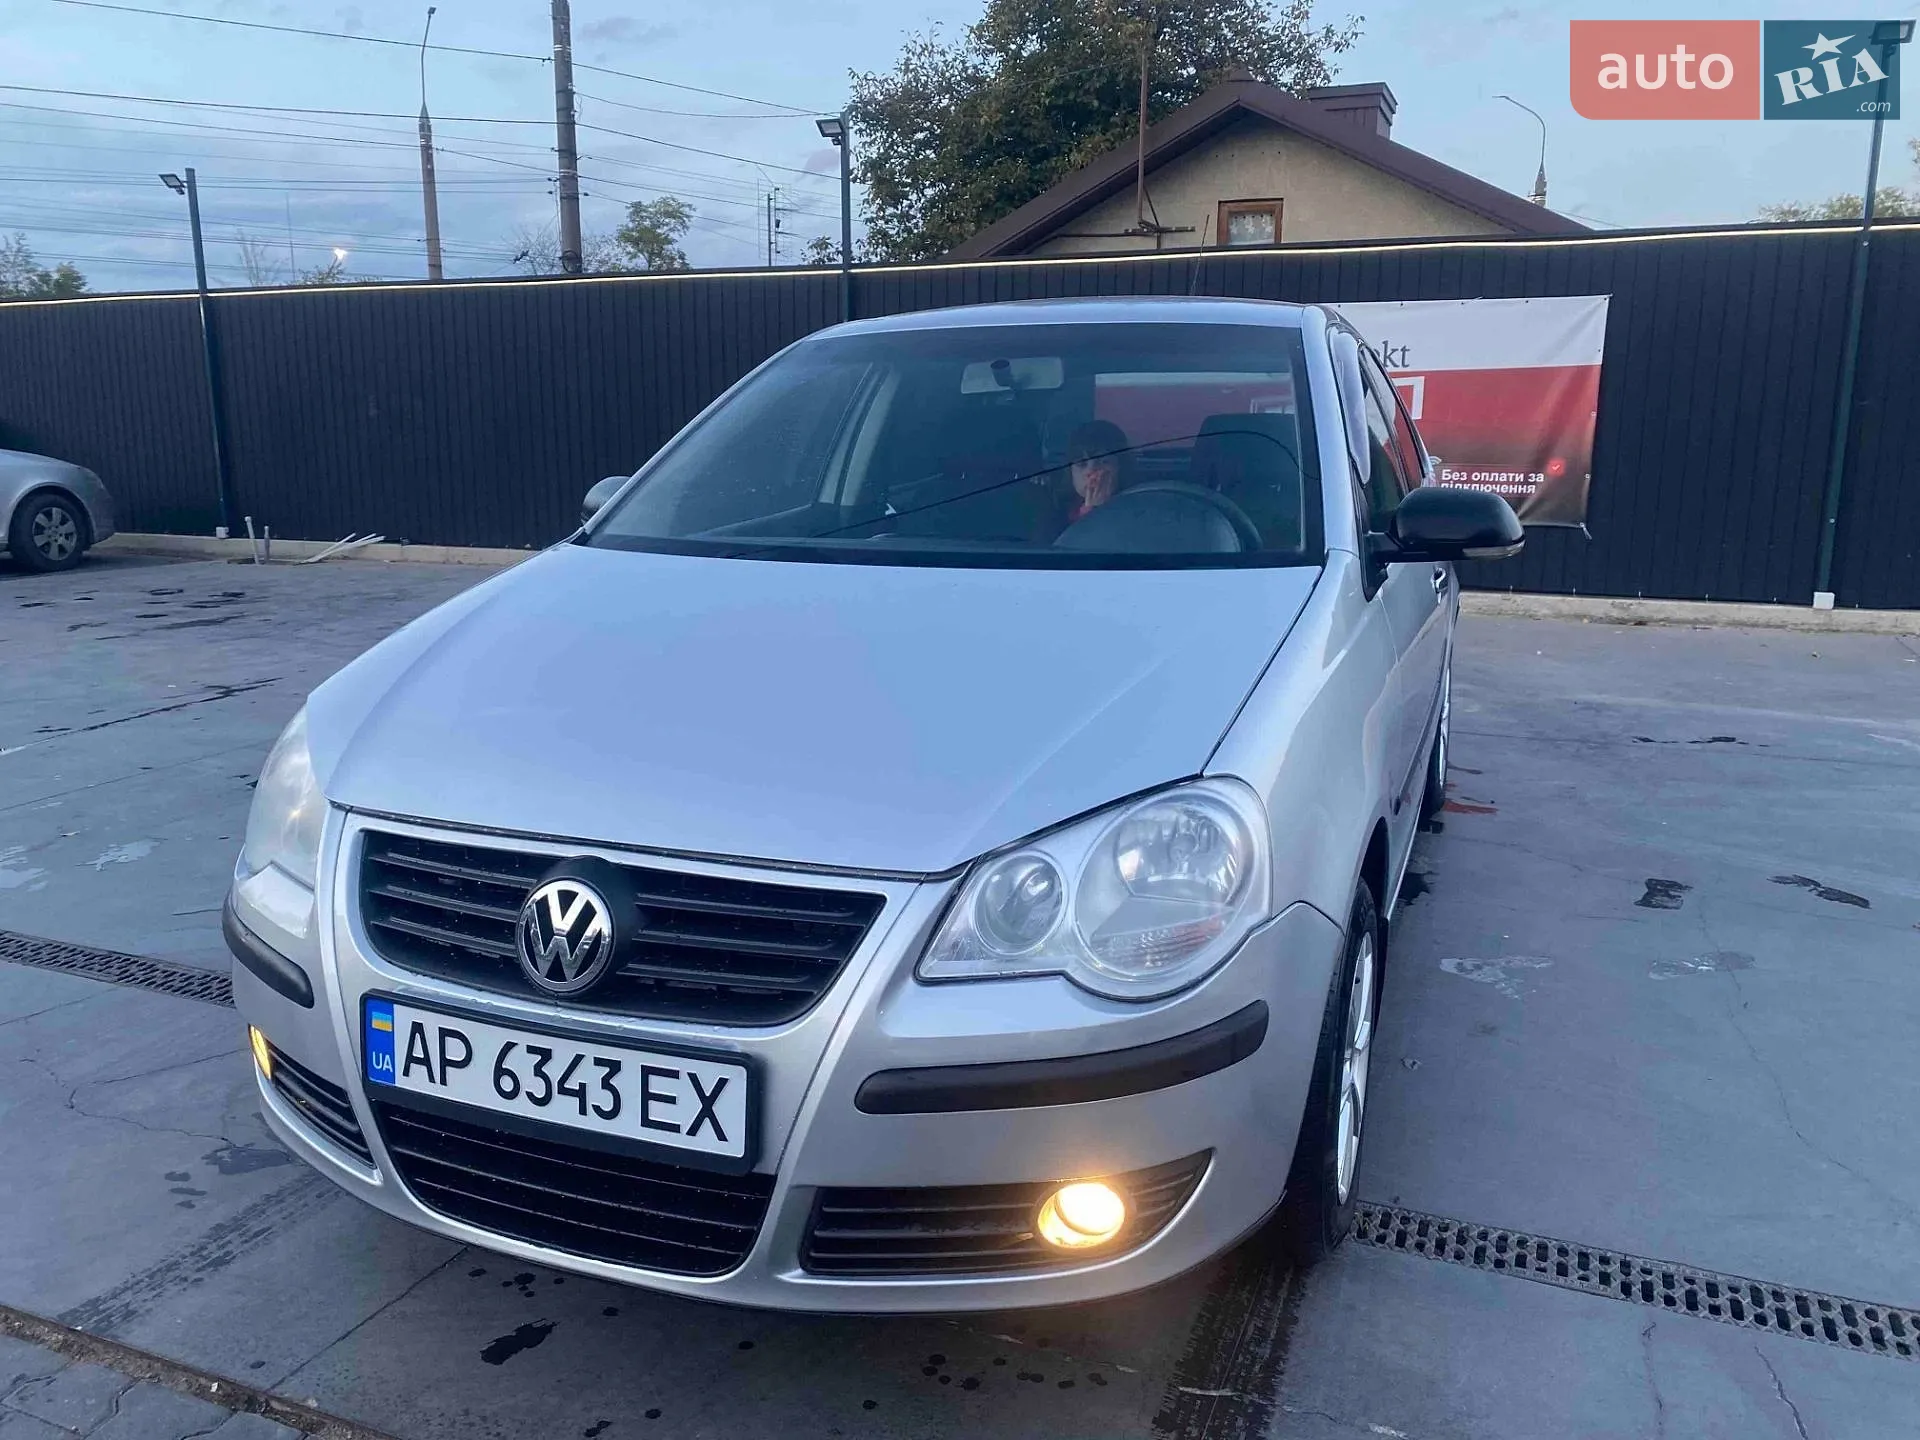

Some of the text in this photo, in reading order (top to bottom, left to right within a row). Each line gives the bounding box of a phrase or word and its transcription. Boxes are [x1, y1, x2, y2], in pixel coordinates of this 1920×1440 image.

[1374, 340, 1411, 368] kt
[1441, 469, 1545, 483] Без оплати за
[520, 882, 612, 986] VW
[372, 1051, 393, 1073] UA
[402, 1021, 729, 1142] AP 6343 EX
